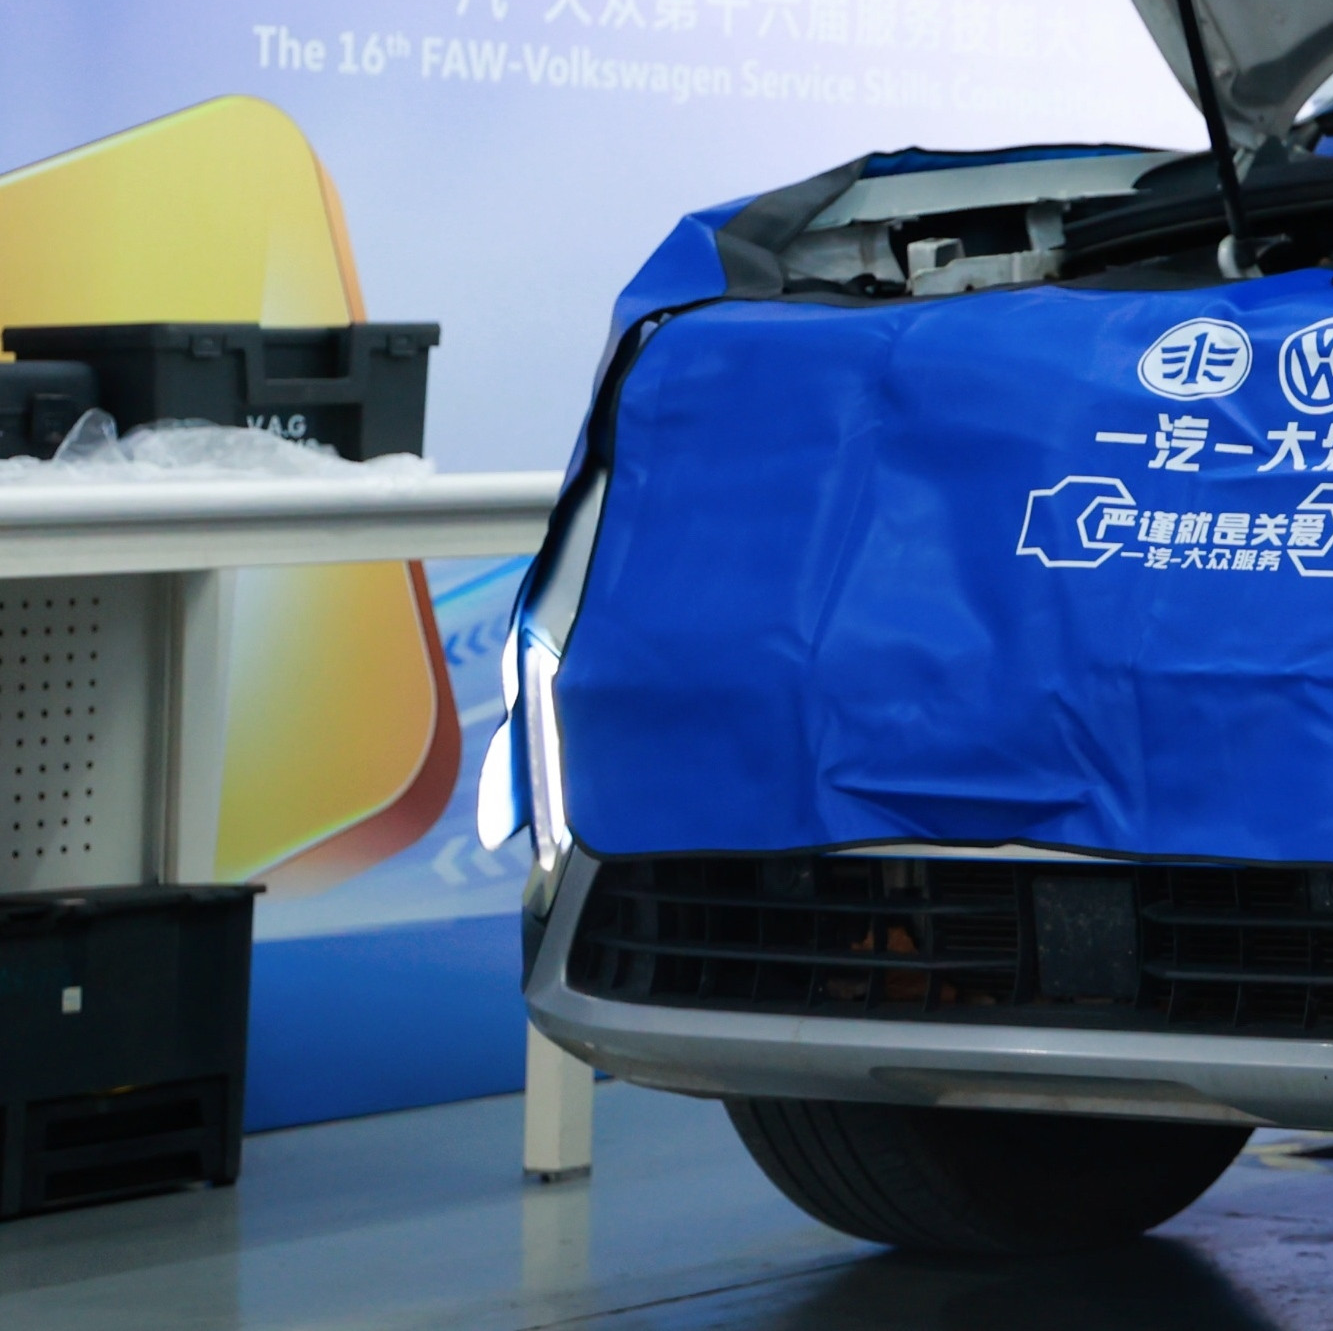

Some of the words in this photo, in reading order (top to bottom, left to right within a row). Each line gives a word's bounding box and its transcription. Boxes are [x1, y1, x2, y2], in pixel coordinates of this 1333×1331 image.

[252, 24, 327, 73] The
[420, 36, 732, 105] FAW-Volkswagen
[740, 57, 857, 105] Service
[1096, 508, 1327, 548] 严谨就是关爱
[1120, 546, 1281, 572] 一汽-大众服务
